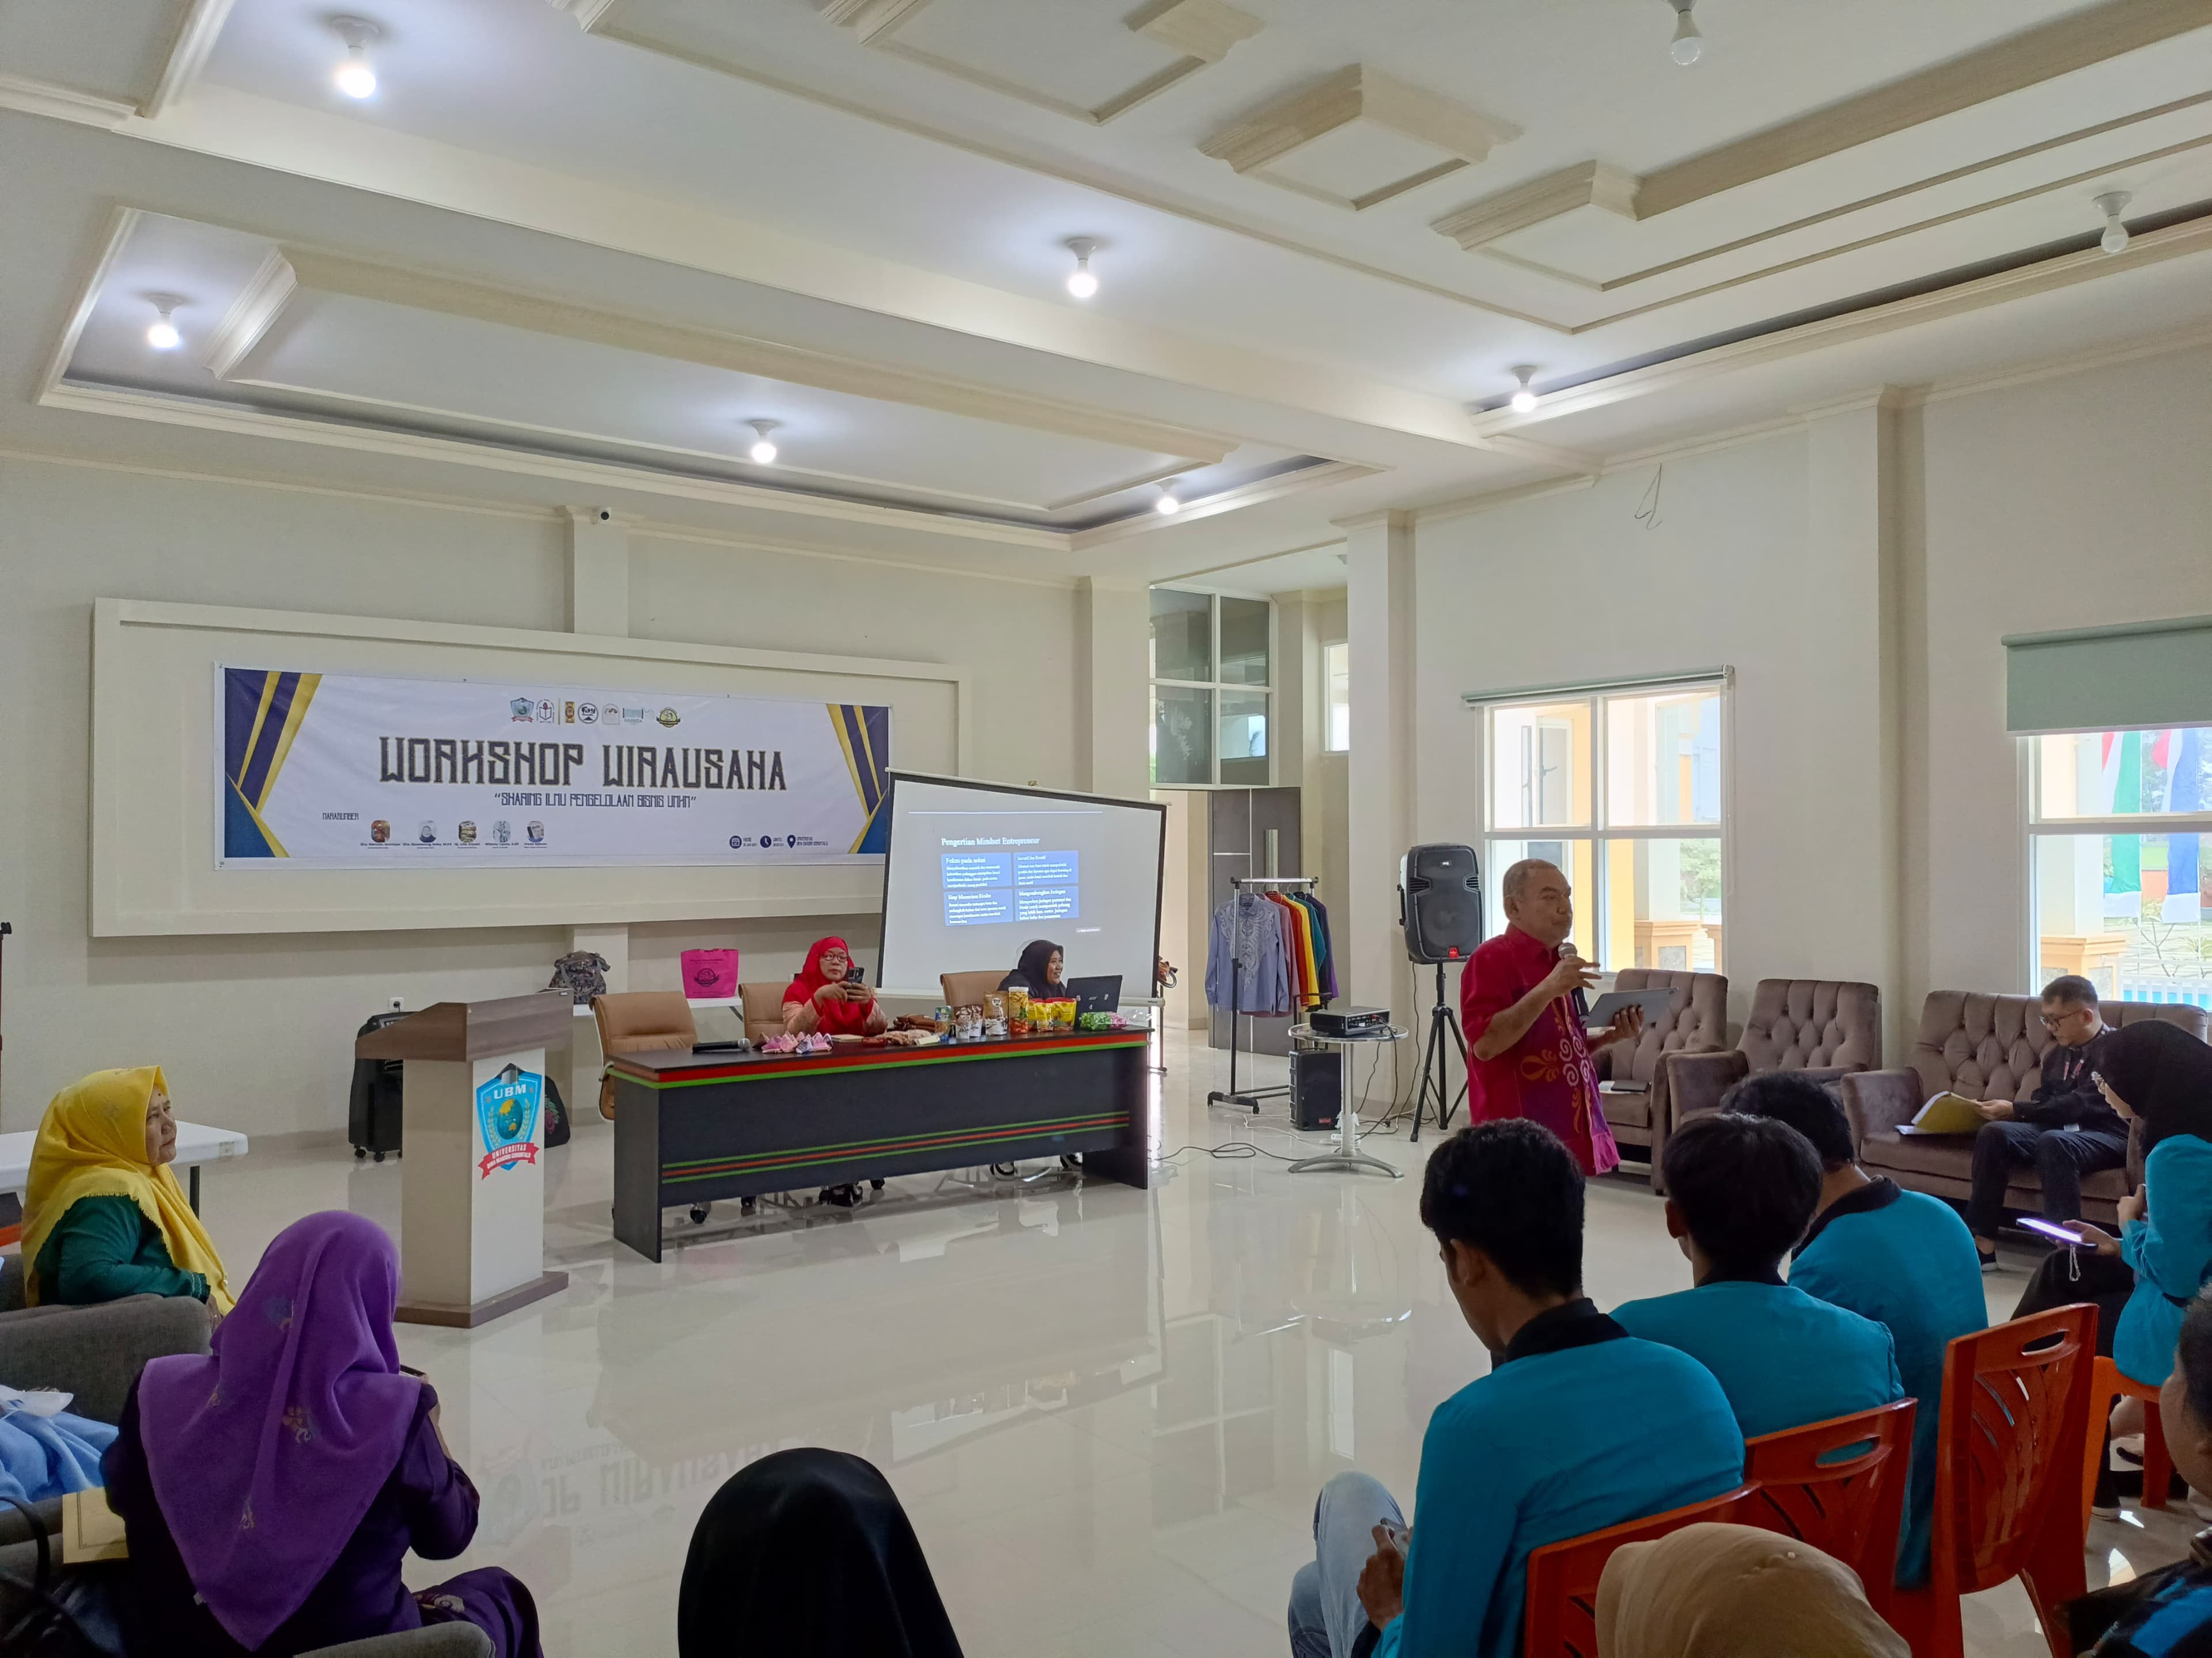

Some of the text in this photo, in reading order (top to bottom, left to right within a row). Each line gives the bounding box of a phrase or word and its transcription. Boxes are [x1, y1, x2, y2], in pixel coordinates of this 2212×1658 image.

[379, 737, 787, 791] WORKSHOP WIRAUSAHA
[546, 793, 566, 806] ILMU
[570, 794, 634, 807] PENGELOLAAN
[637, 795, 664, 807] BISNIS
[941, 837, 1040, 847] Pengertian Mindset Entrepreneur
[494, 1084, 527, 1099] UBM
[492, 1144, 527, 1159] UNIVERSITAS
